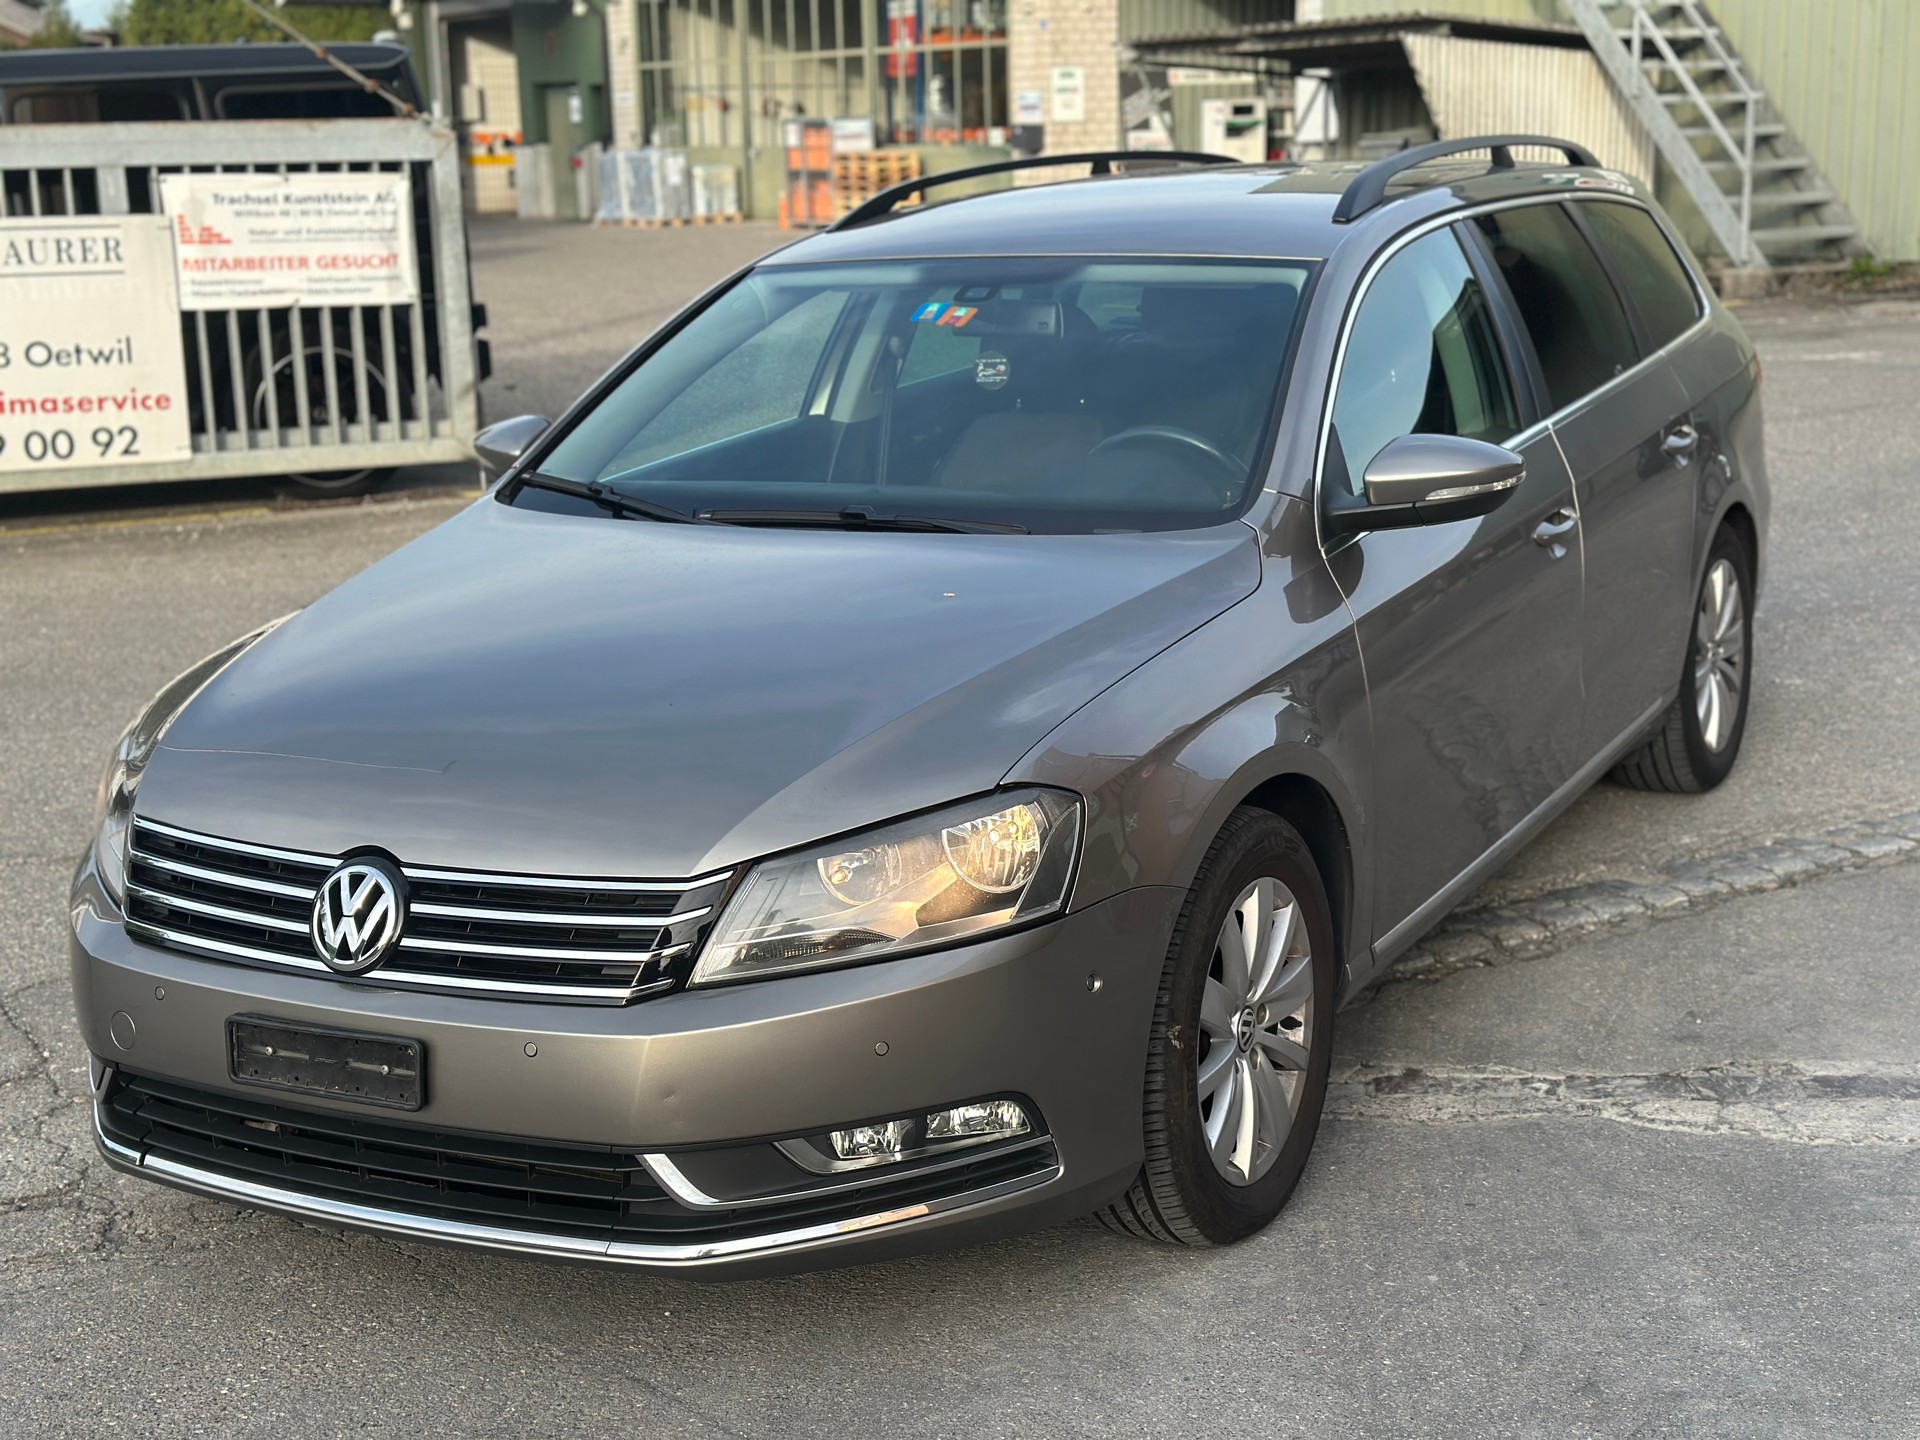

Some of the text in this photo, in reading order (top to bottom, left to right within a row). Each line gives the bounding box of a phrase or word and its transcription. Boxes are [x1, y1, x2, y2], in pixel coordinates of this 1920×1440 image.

[283, 191, 369, 205] Kunststein
[3, 236, 123, 266] AURER
[182, 252, 399, 272] MITARBEITER GESUCHT
[24, 335, 133, 367] Oetwil
[24, 430, 75, 462] 00
[91, 425, 140, 457] 92
[313, 865, 395, 965] VW
